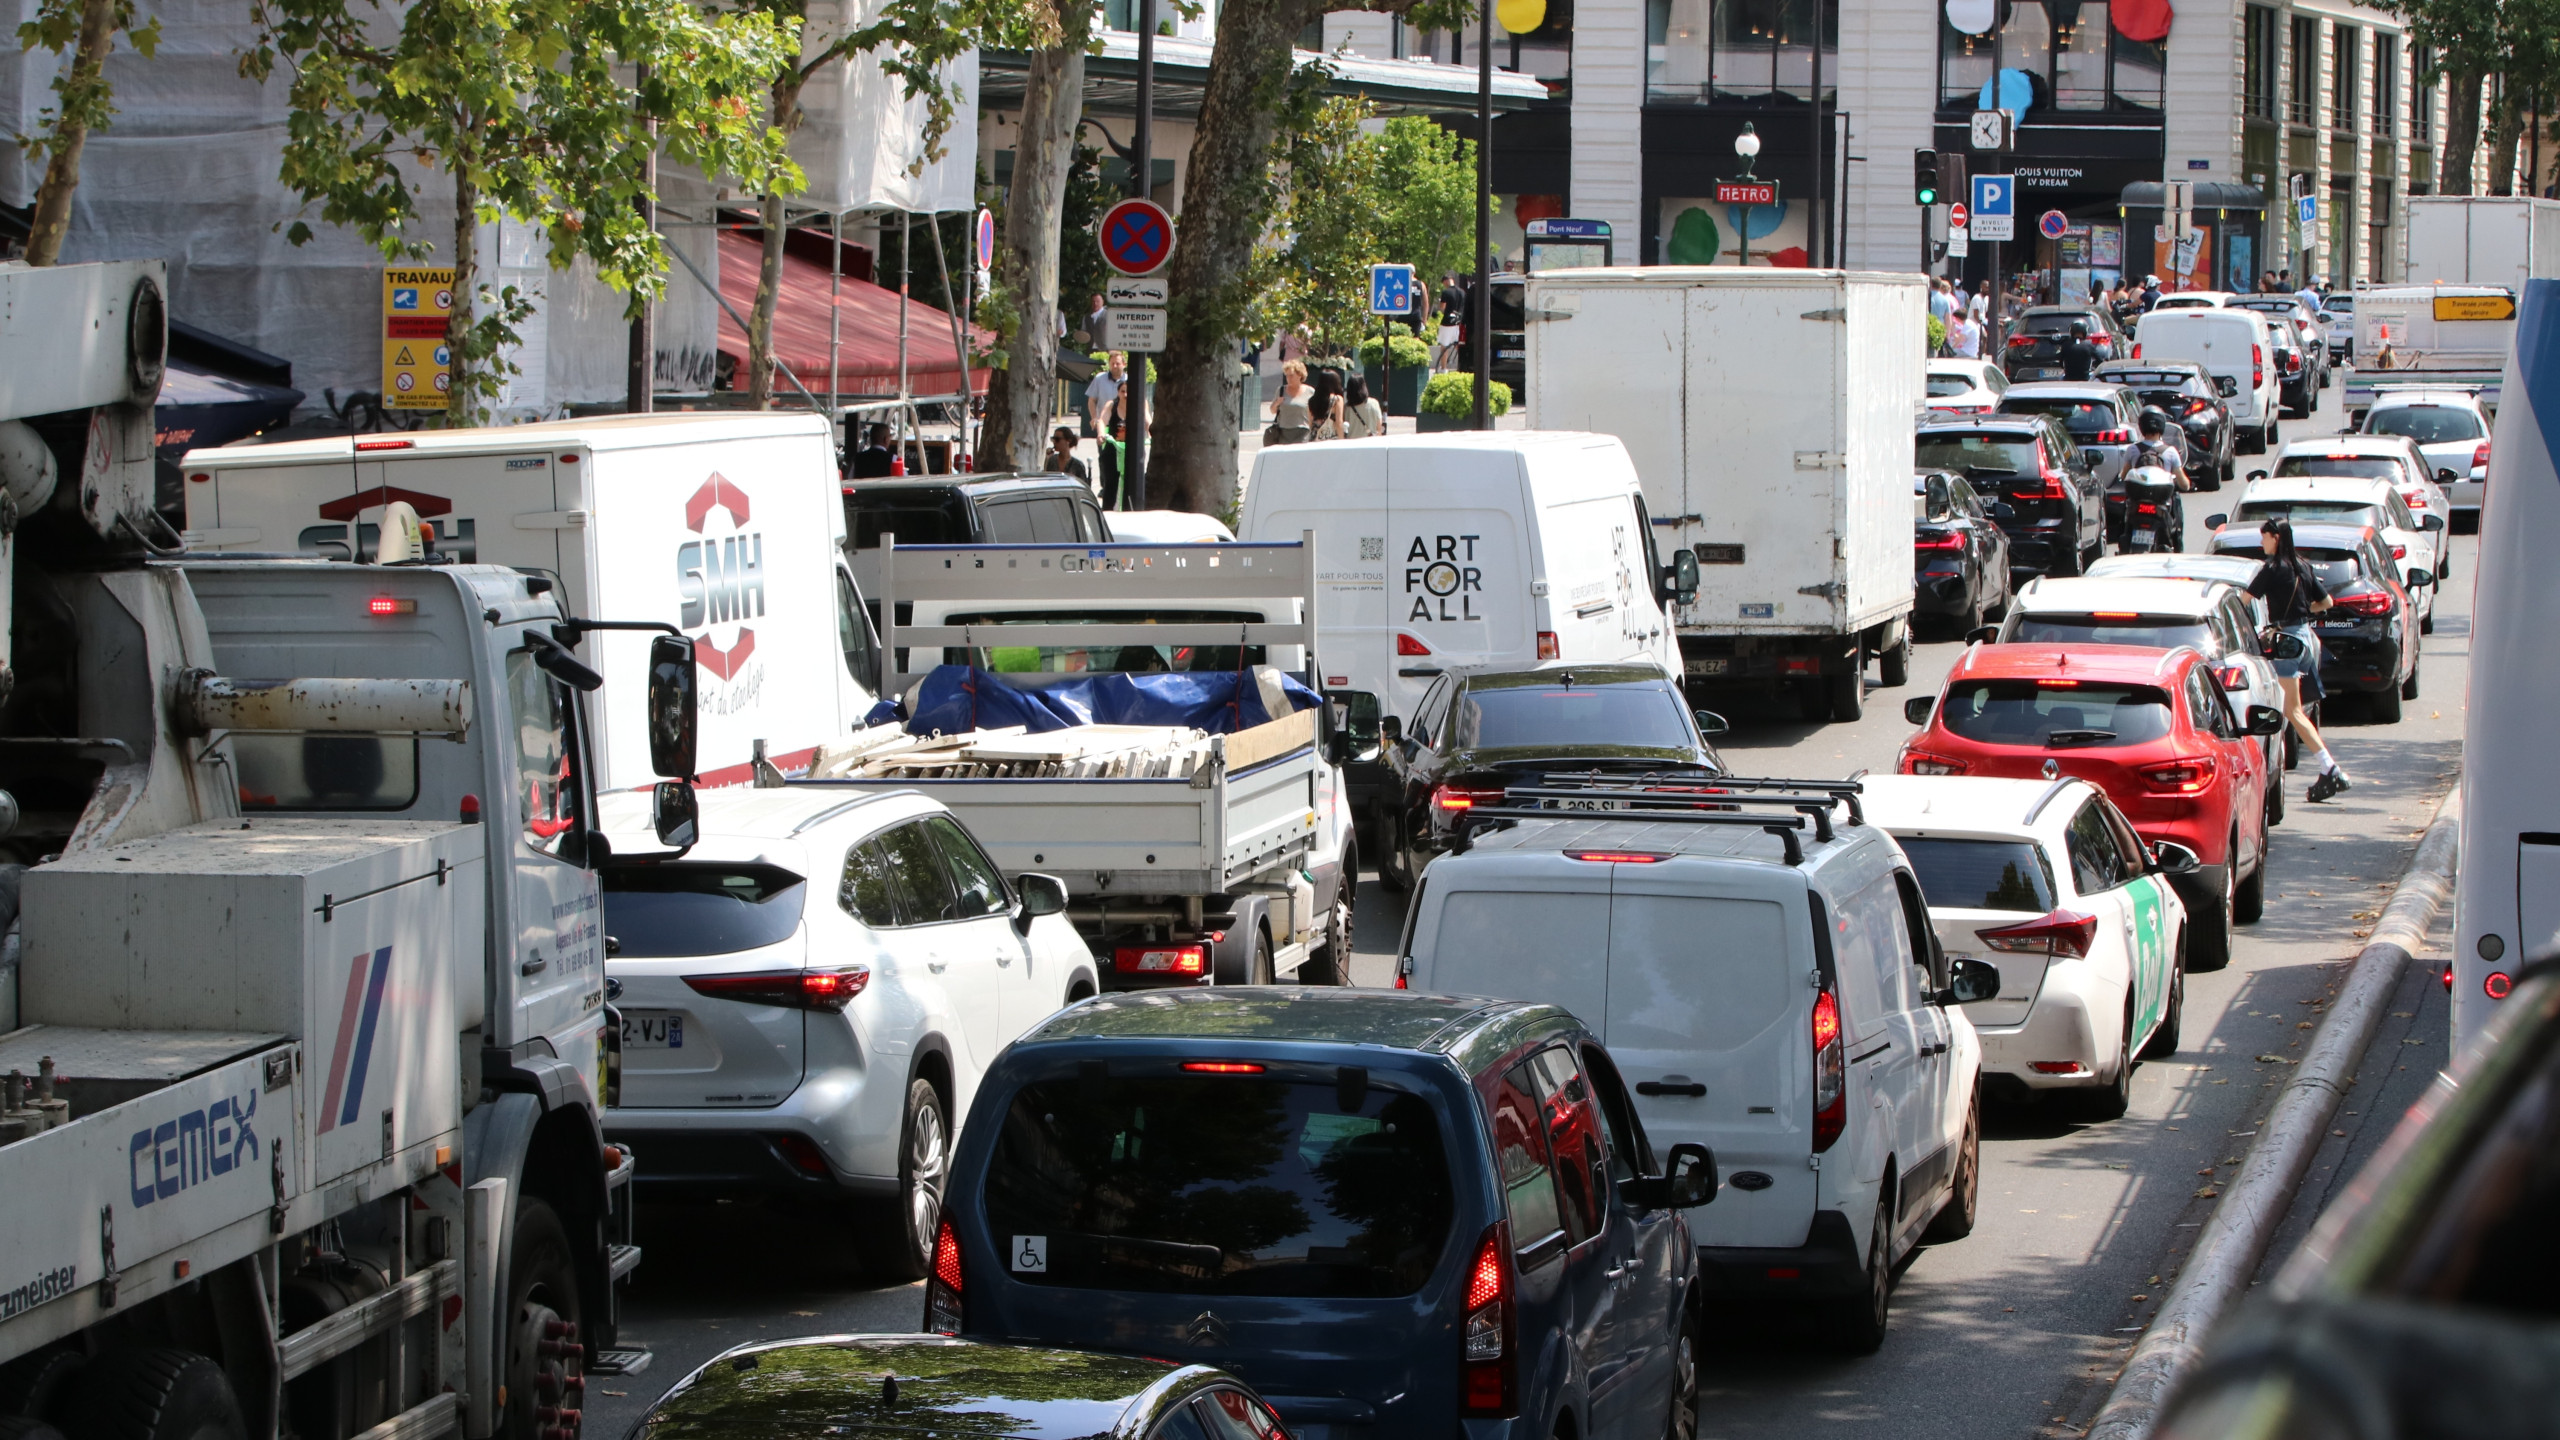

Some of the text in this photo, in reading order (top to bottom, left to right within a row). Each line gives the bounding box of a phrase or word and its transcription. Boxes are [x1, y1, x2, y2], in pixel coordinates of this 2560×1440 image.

[2014, 167, 2083, 178] LOUIS VUITTON
[2027, 178, 2069, 187] LV DREAM
[1983, 183, 2002, 210] P
[1548, 225, 1584, 234] Pont Neuf
[1116, 313, 1155, 321] INTERDIT
[1406, 535, 1480, 562] ART
[1059, 553, 1134, 573] Gruau
[677, 532, 765, 630] SMH
[1361, 572, 1384, 580] TOUS
[1405, 560, 1482, 597] FOR
[1408, 594, 1481, 622] ALL
[2325, 620, 2353, 628] telecom
[622, 1019, 682, 1044] 2-VJ 2A
[130, 1088, 259, 1209] CEMEX
[0, 1264, 77, 1319] zmeister
